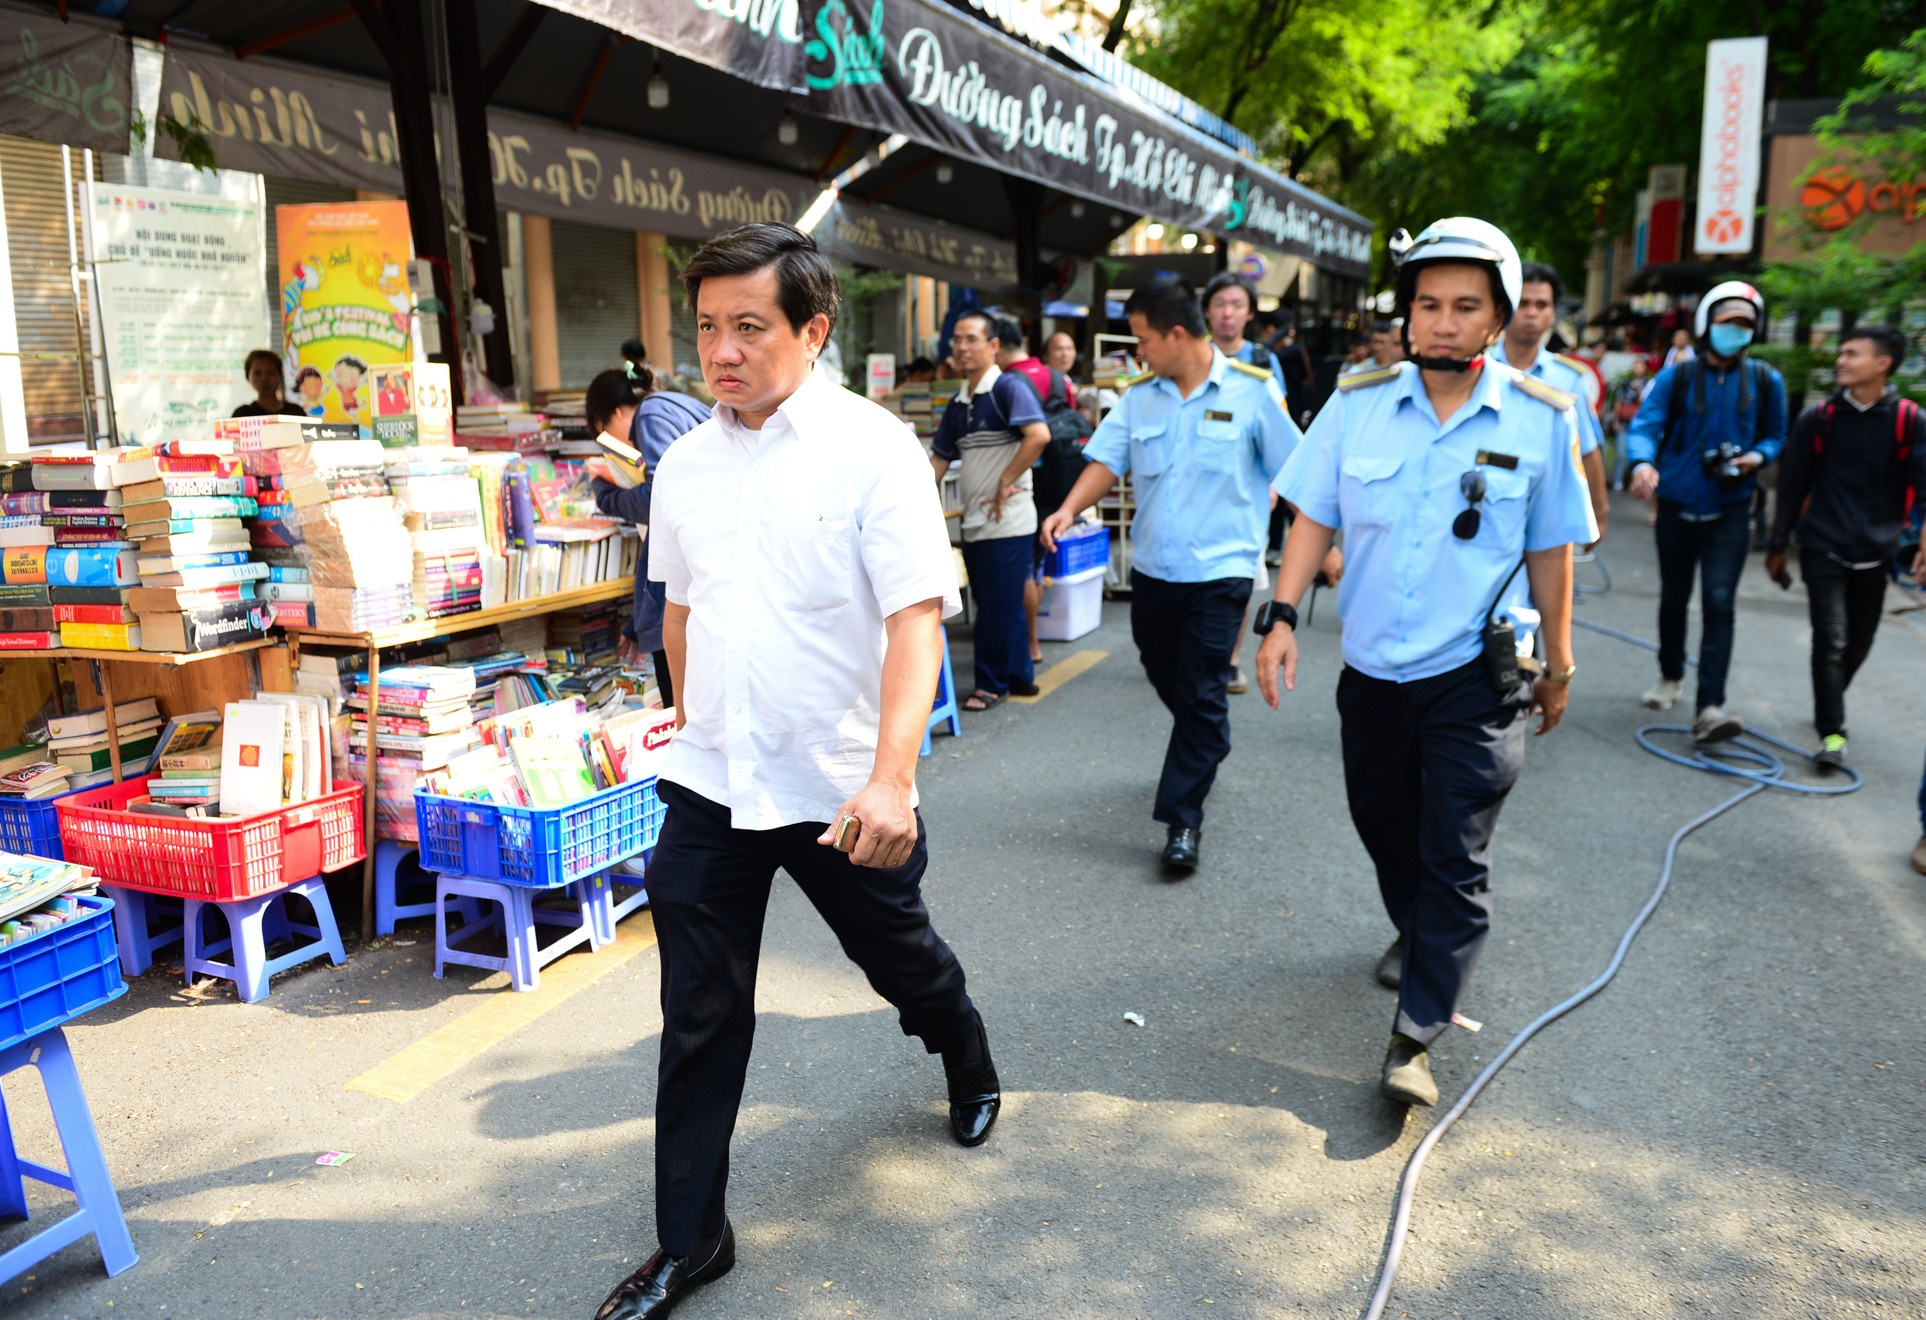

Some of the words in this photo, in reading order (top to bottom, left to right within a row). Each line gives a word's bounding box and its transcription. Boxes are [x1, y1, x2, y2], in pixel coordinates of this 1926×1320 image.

[804, 0, 887, 90] Sách
[898, 27, 1023, 152] Đường
[1024, 84, 1091, 165] Sách
[1711, 63, 1744, 208] alphabooks
[200, 617, 248, 637] Wordfinder
